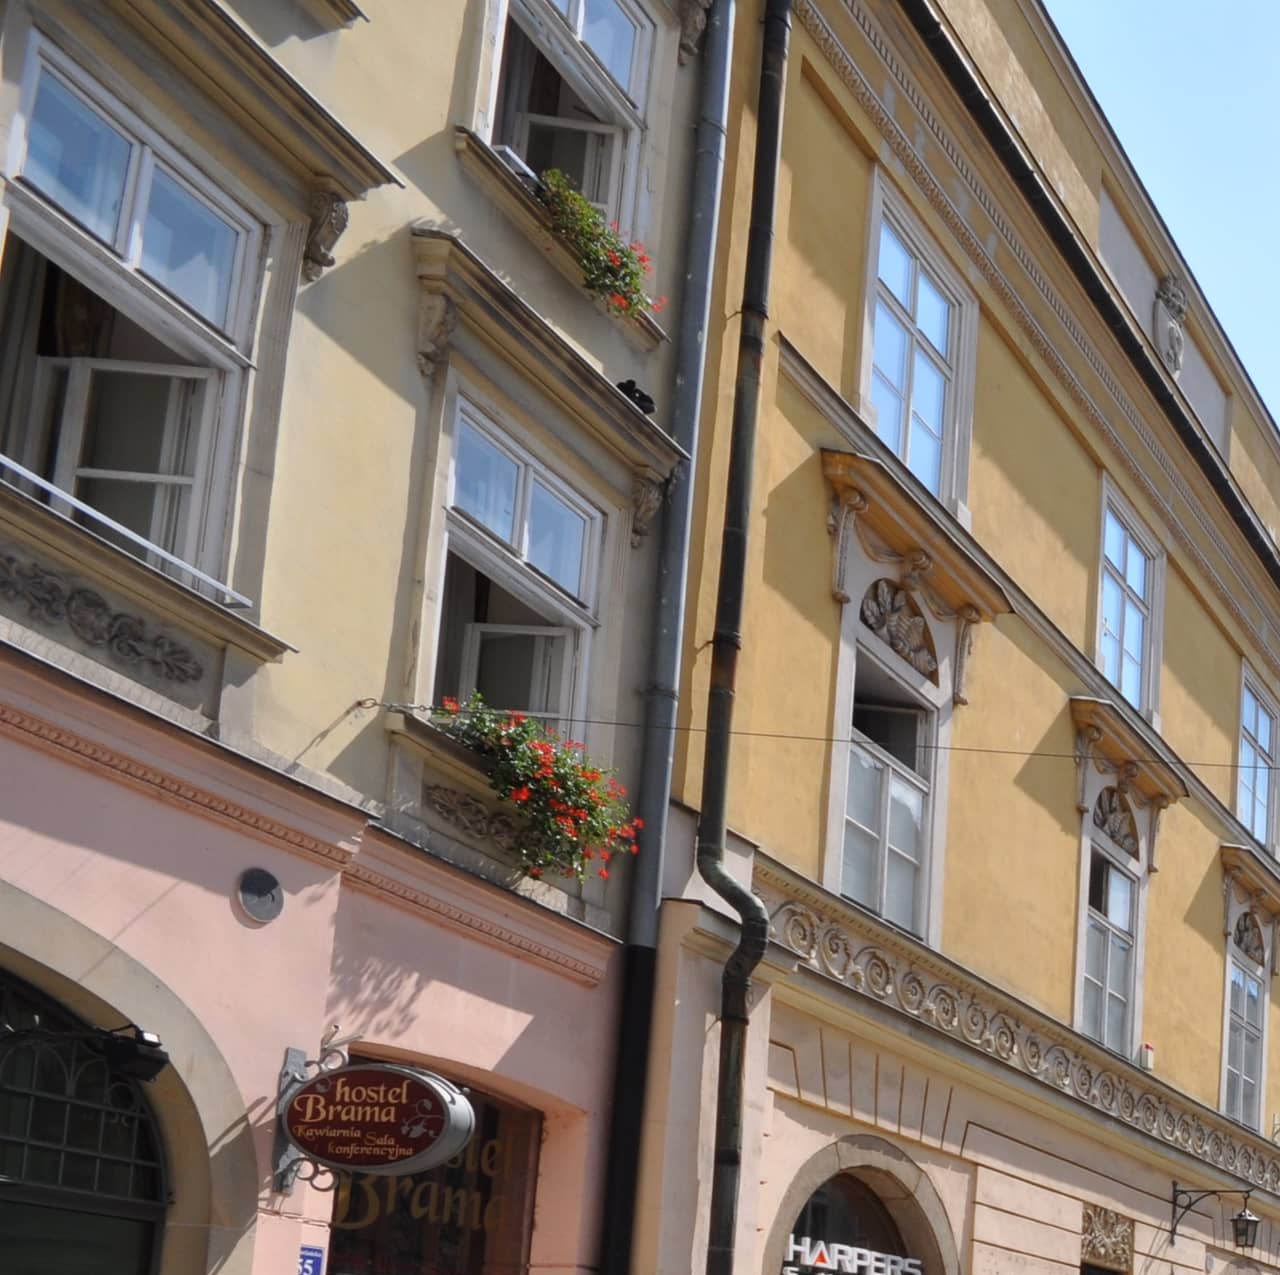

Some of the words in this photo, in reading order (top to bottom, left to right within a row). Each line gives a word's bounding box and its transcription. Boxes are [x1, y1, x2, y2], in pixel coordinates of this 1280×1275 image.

[336, 1078, 411, 1105] hostel
[294, 1094, 396, 1123] Brama
[292, 1125, 361, 1141] Kawiarnia
[364, 1133, 395, 1146] Sala
[328, 1143, 414, 1160] konferencyjna
